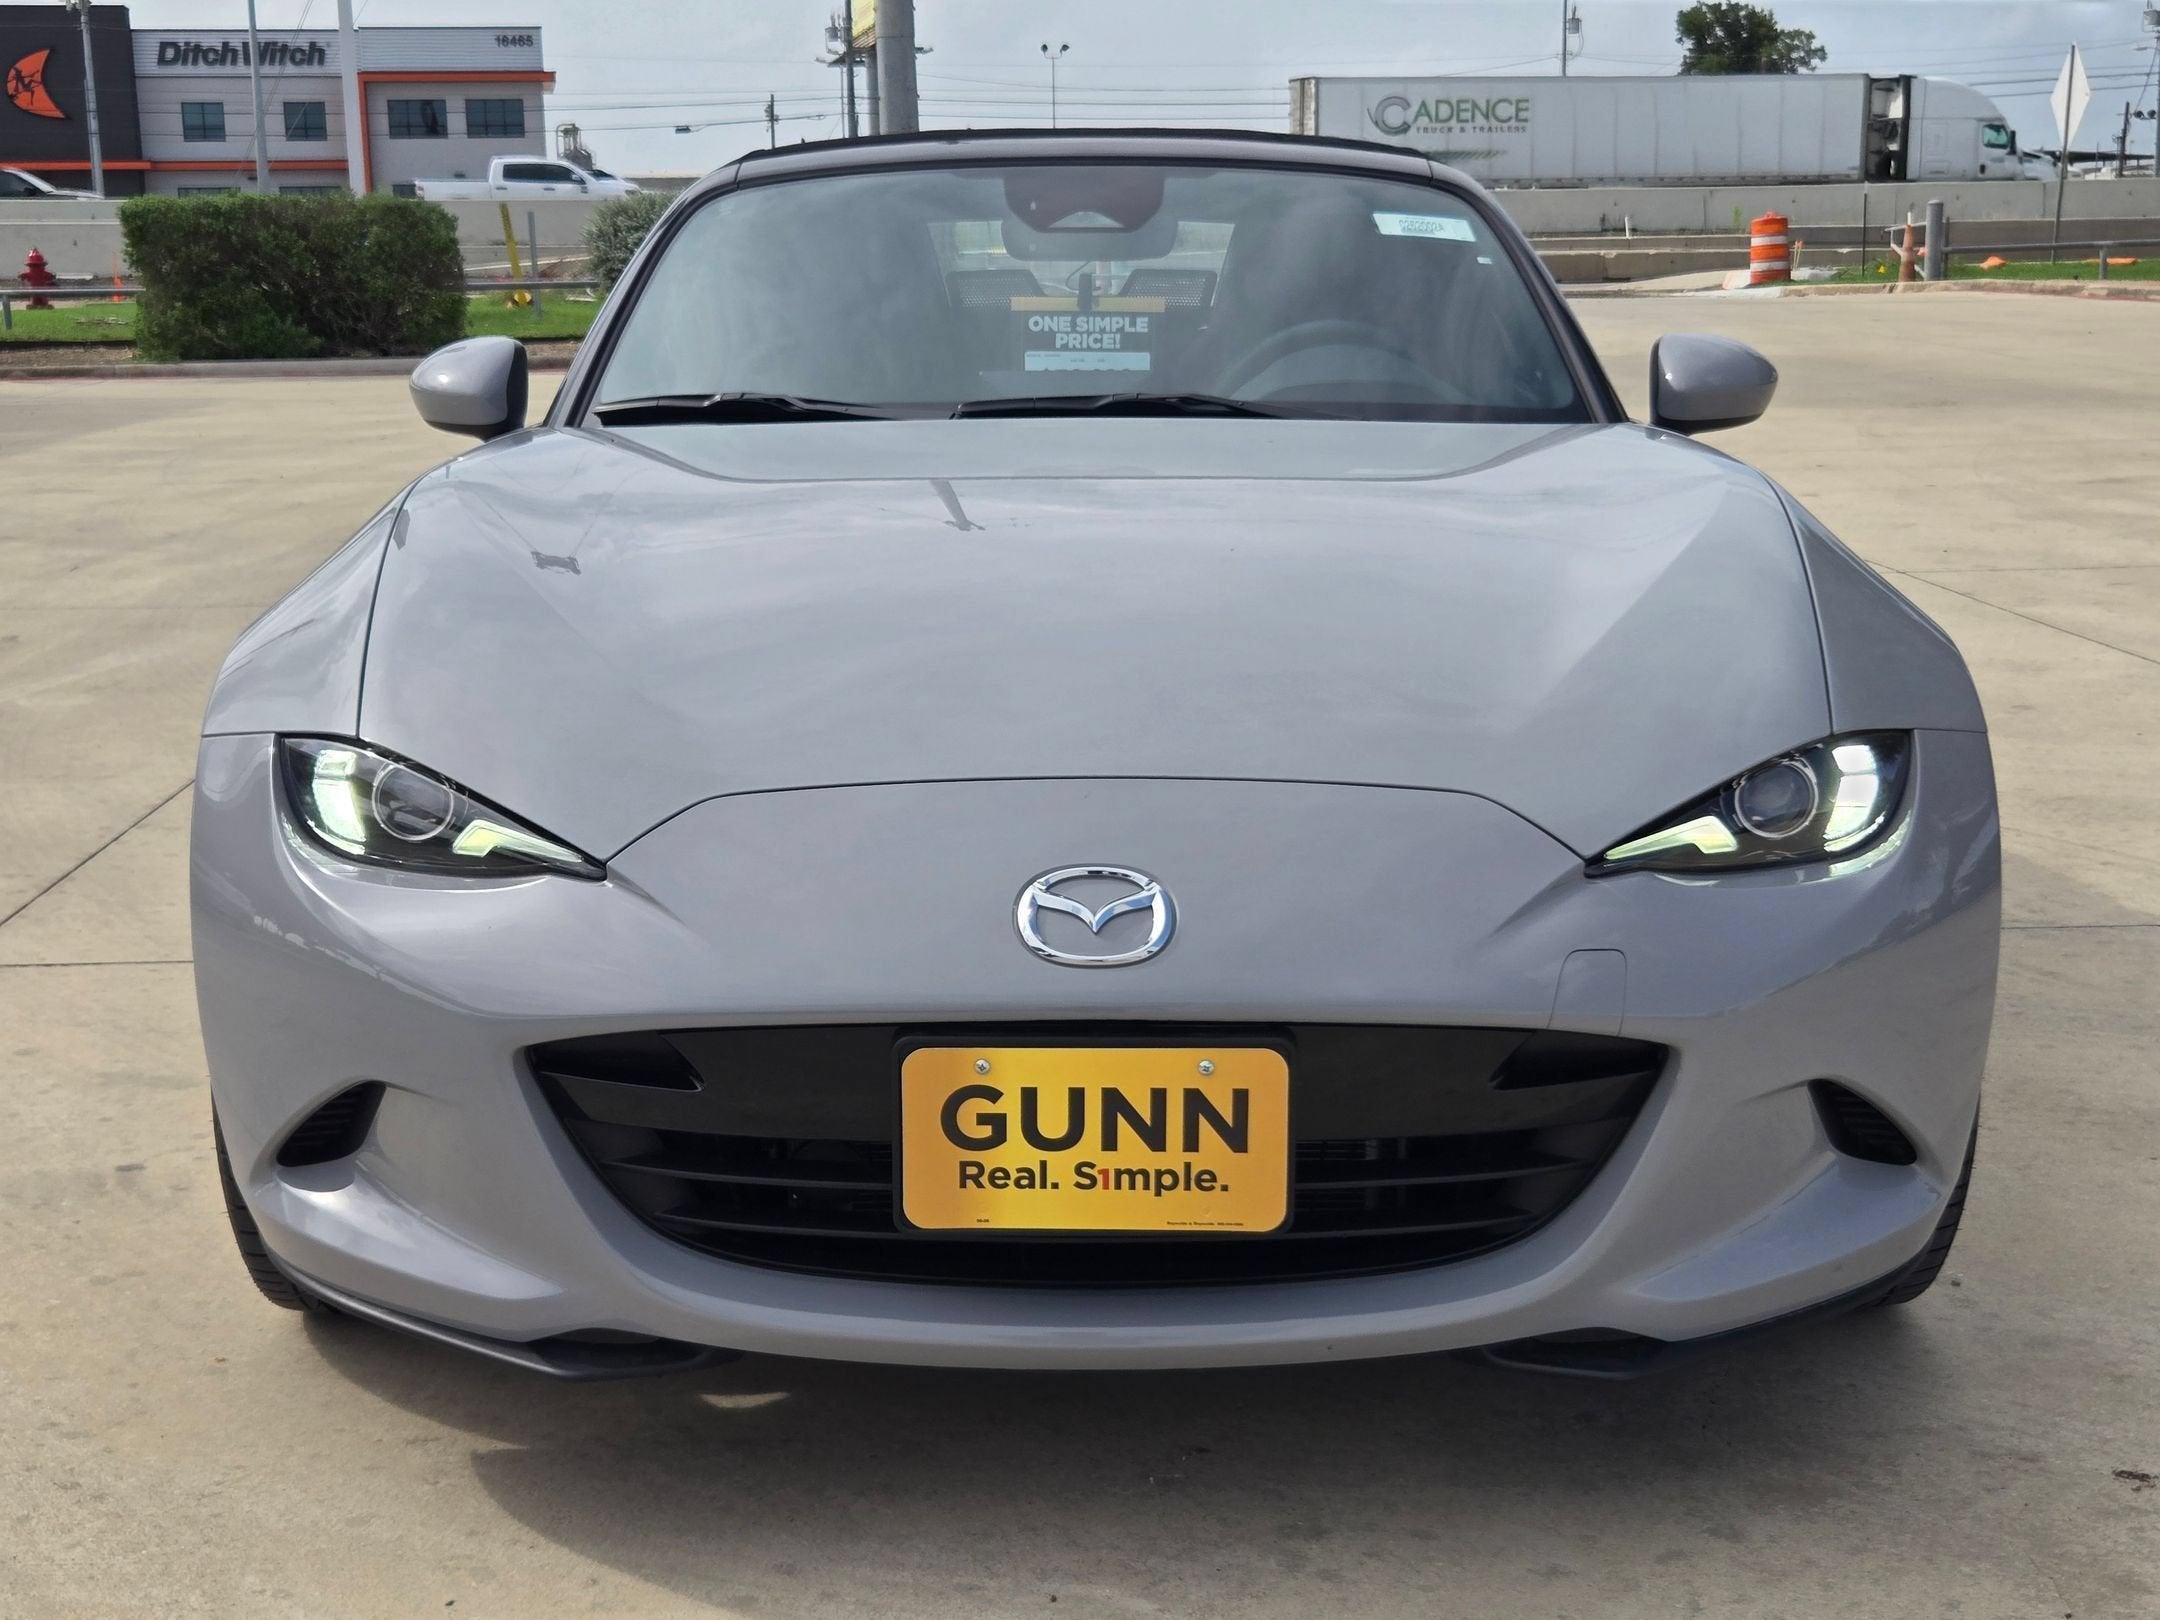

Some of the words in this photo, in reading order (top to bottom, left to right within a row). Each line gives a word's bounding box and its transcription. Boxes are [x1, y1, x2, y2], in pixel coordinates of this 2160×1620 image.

[157, 41, 239, 66] Ditch
[241, 41, 326, 66] Witch
[1367, 95, 1530, 136] CADENCE
[1416, 126, 1453, 134] TRUCK
[1472, 126, 1528, 134] TRAILERS
[1028, 315, 1072, 332] ONE
[1076, 316, 1149, 333] SIMPLE
[1055, 333, 1121, 349] PRICE!
[940, 1084, 1249, 1153] GUNN
[959, 1160, 1060, 1190] Real.
